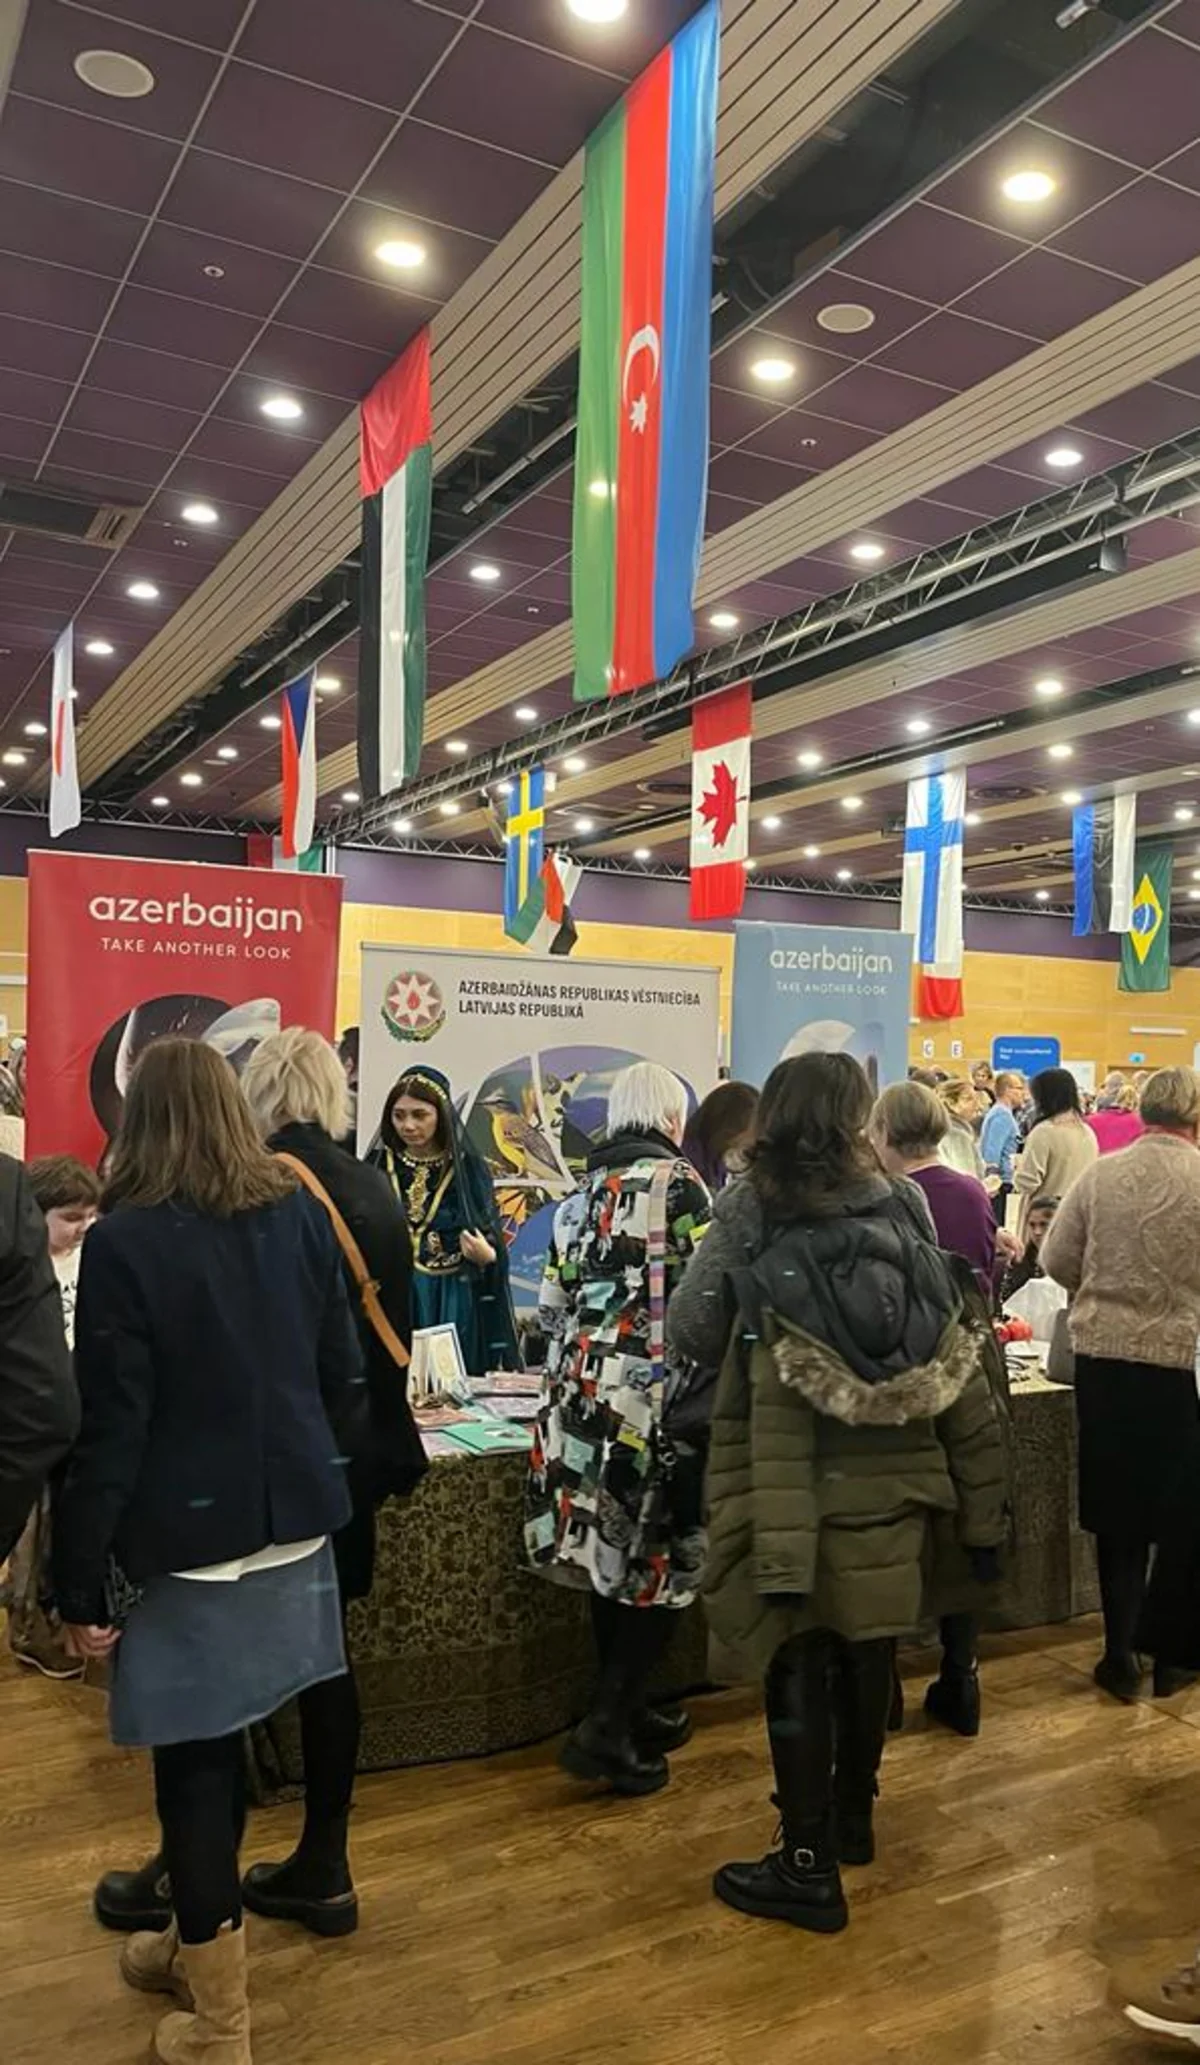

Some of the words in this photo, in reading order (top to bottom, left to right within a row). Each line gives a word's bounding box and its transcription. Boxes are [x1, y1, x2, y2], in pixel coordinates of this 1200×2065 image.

[89, 893, 302, 938] azerbaijan
[101, 937, 146, 953] TAKE
[152, 940, 237, 957] ANOTHER
[244, 945, 292, 960] LOOK
[770, 944, 893, 979] azerbaijan
[560, 986, 630, 1003] REPUBLIKAS
[631, 989, 701, 1005] VĒSTNIECĪBA
[776, 980, 802, 993] TAKE
[804, 983, 855, 995] ANOTHER
[856, 984, 890, 996] LOOK
[459, 999, 517, 1016] LATVIJAS
[519, 1001, 584, 1019] REPUBLIKĀ
